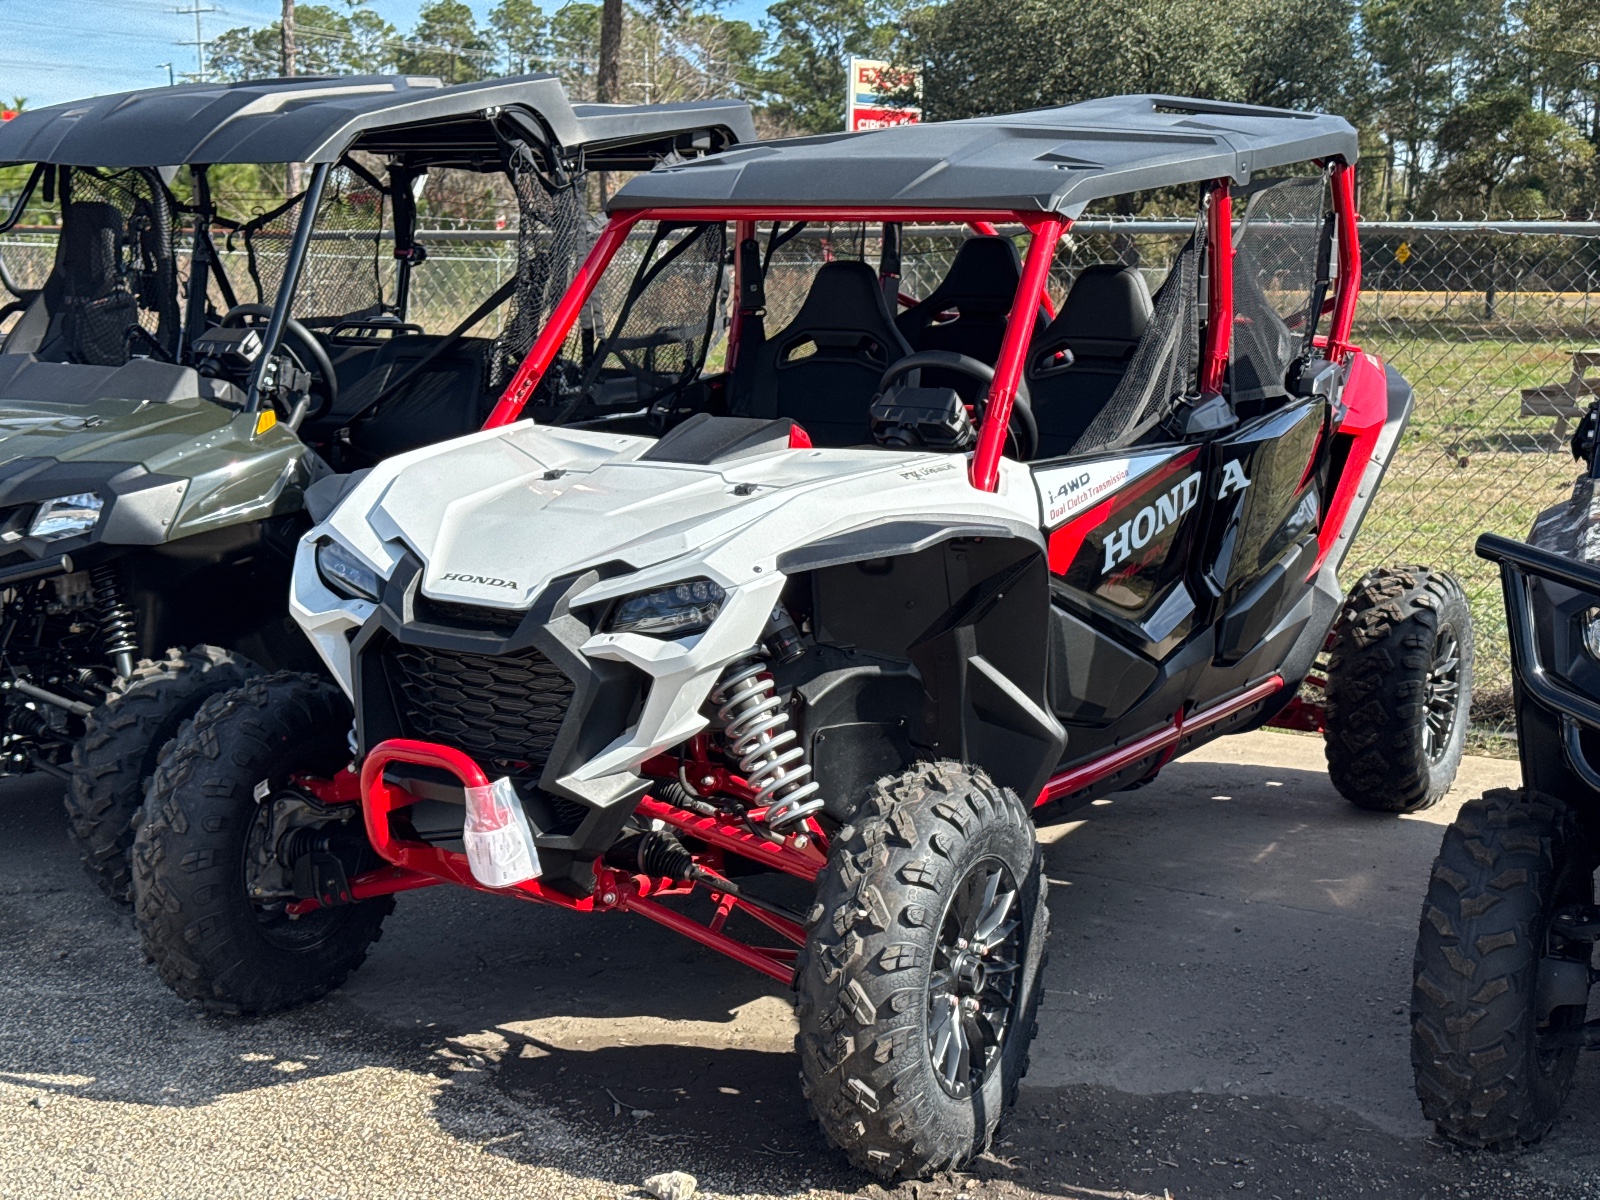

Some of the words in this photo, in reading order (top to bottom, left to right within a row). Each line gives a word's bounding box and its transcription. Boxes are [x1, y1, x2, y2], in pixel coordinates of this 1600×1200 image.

[1048, 472, 1090, 504] i-4WD
[1050, 503, 1066, 520] Dual
[1067, 491, 1088, 511] Clutch
[1087, 469, 1130, 498] Transmission
[1101, 458, 1252, 575] HONDA
[440, 572, 518, 590] HONDA
[1105, 537, 1167, 593] TALON
